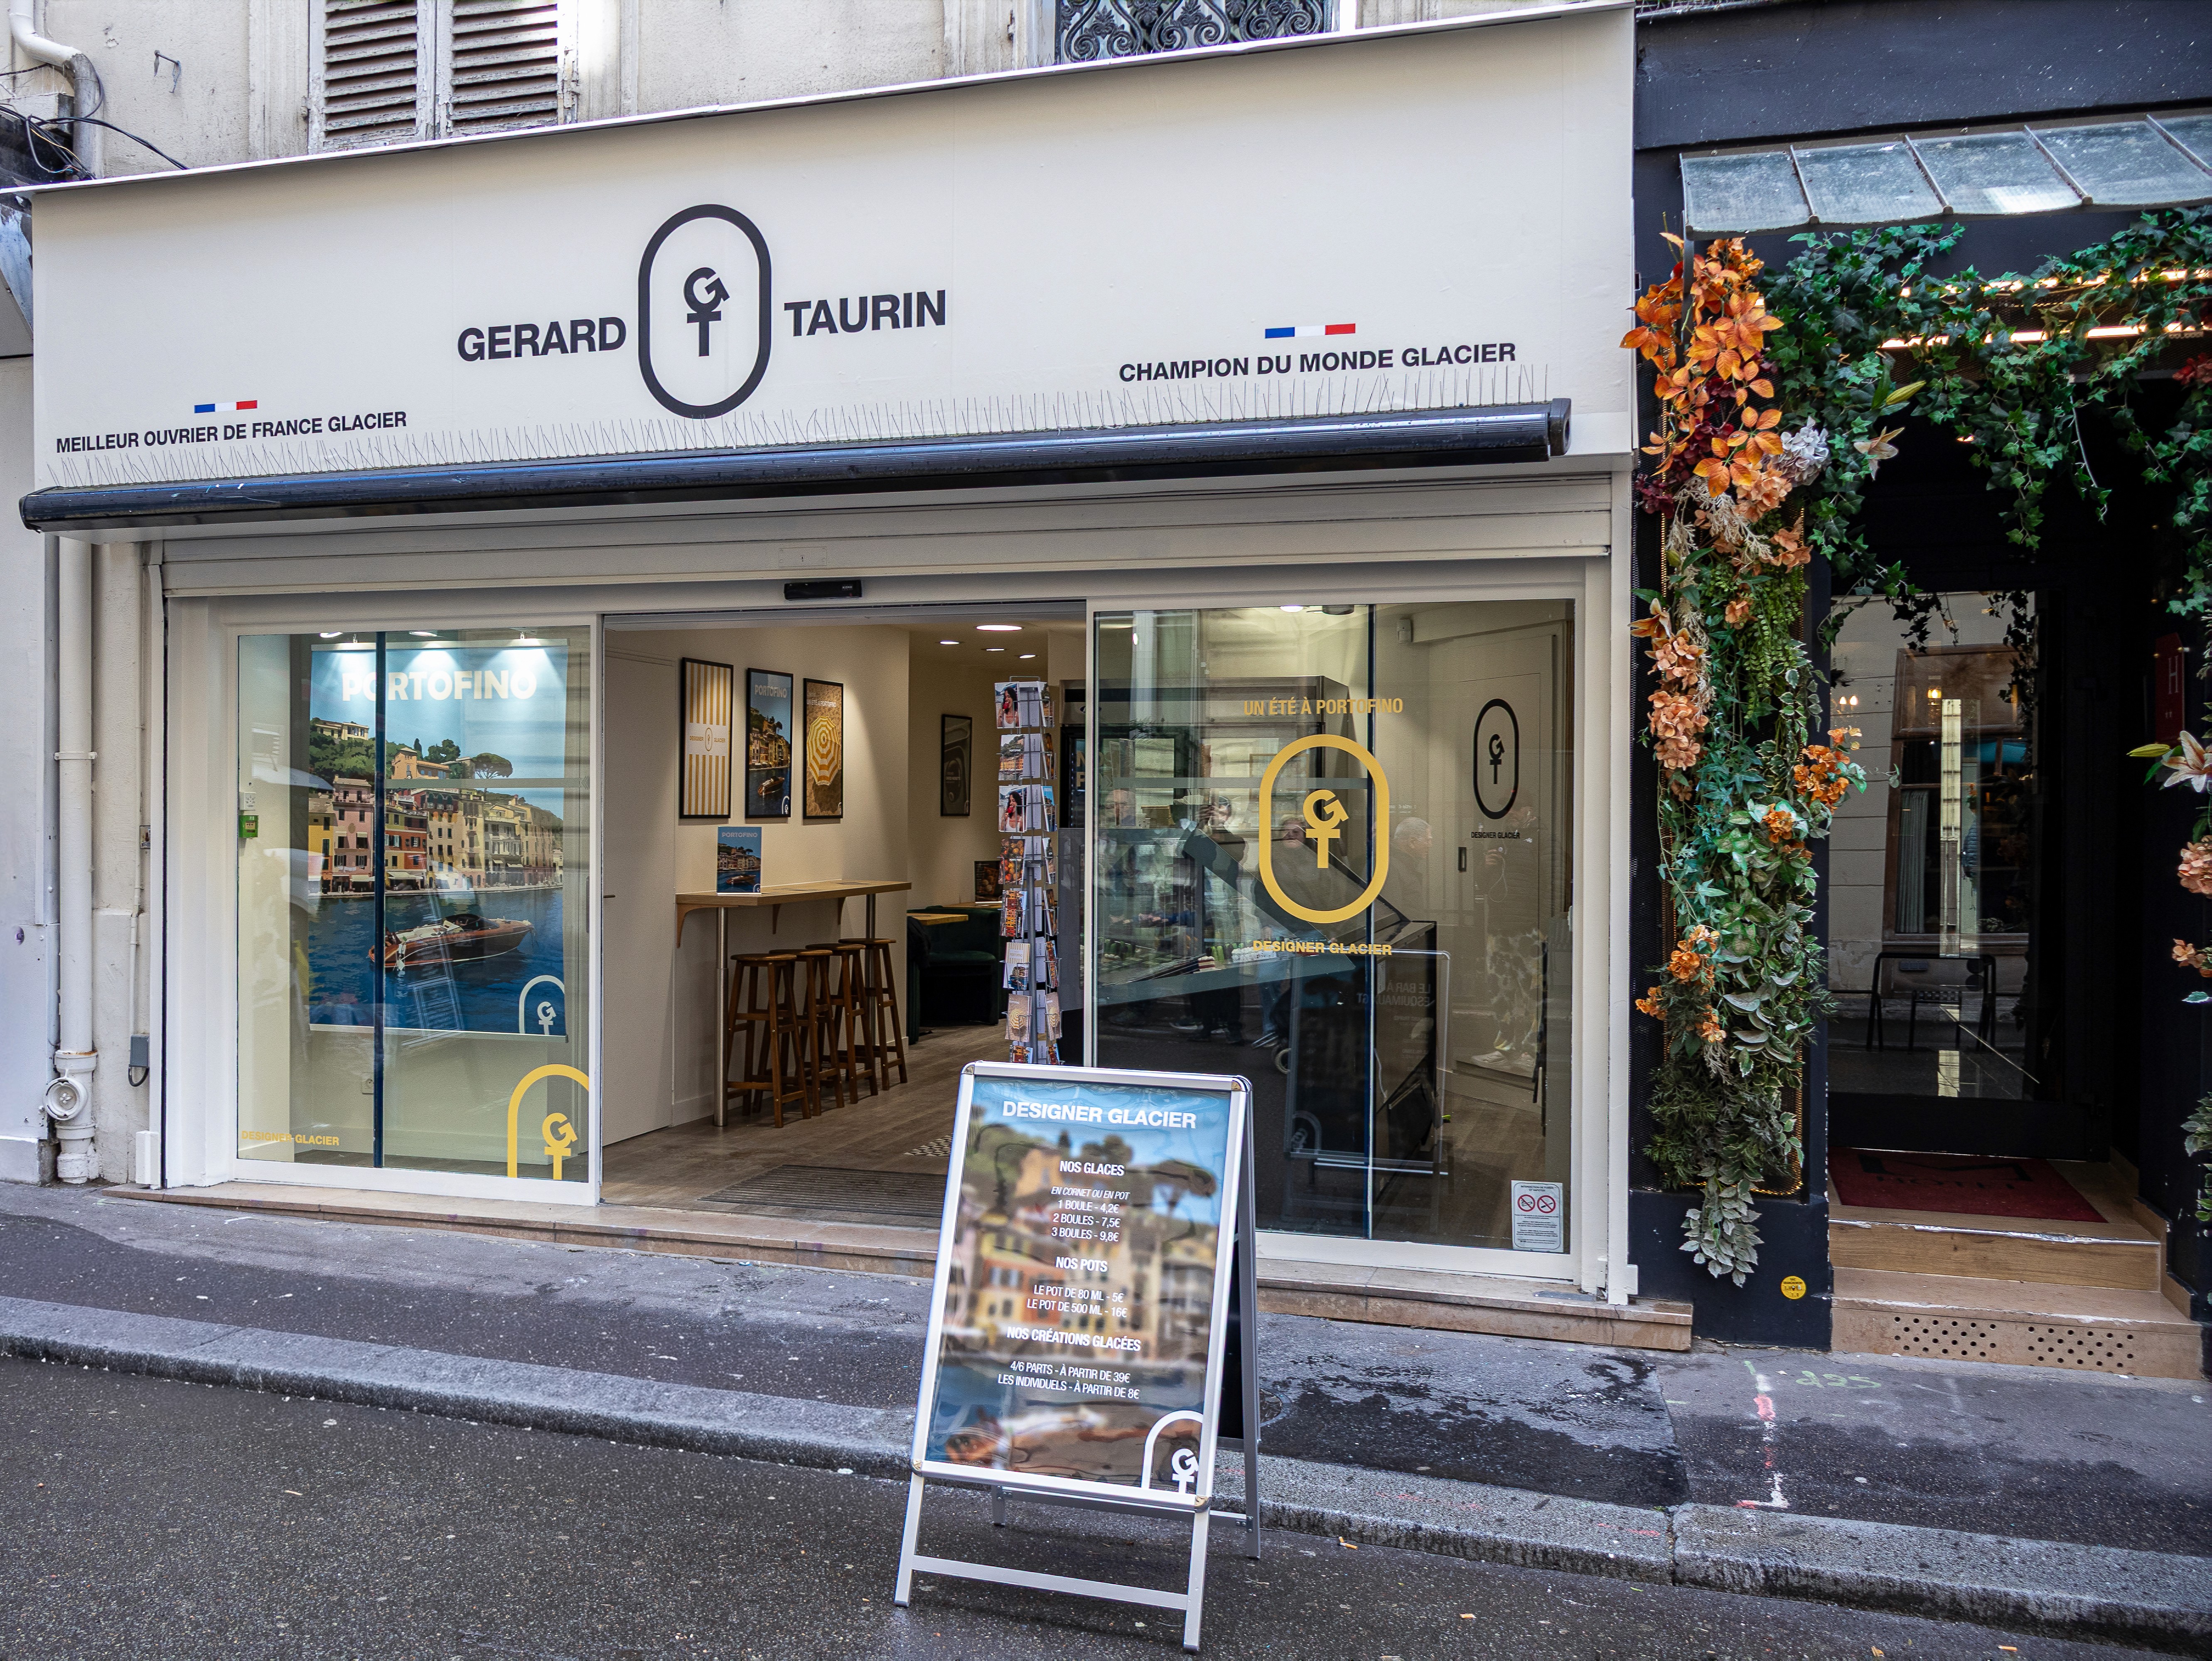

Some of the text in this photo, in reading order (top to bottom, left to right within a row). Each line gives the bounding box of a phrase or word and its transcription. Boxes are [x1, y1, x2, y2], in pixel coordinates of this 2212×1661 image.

[458, 317, 626, 361] GERARD
[784, 290, 945, 336] TAURIN
[1119, 343, 1515, 382] CHAMPION DU MONDE GLACIER
[57, 412, 406, 453] MEILLEUR OUVRIER DE FRANCE GLACIER
[342, 670, 537, 702] PORTOFINO
[755, 685, 787, 698] PORTOFINO
[1244, 697, 1403, 715] UN ÉTÉ À PORTOFINO
[1253, 940, 1391, 955] DESIGNER GLACIER
[1003, 1101, 1196, 1129] DESIGNER GLACIER
[241, 1131, 339, 1145] DESIGNER GLACIER
[1060, 1161, 1124, 1176] NOS GLACES
[1062, 1187, 1091, 1197] CORNET
[1091, 1190, 1103, 1198] OU
[1104, 1190, 1114, 1199] EN
[1114, 1191, 1130, 1200] POT
[1058, 1200, 1062, 1209] 1
[1065, 1200, 1093, 1211] BOULE
[1100, 1203, 1119, 1213] 4,2€
[1053, 1213, 1059, 1222] 2
[1060, 1214, 1094, 1225] BOULES
[1102, 1217, 1121, 1228] 7,5€
[1052, 1227, 1057, 1236] 3
[1059, 1227, 1092, 1239] BOULES
[1100, 1231, 1119, 1242] 9,8€
[1055, 1256, 1107, 1271] NOS POTS
[1034, 1284, 1044, 1295] LE
[1046, 1286, 1064, 1296] POT
[1064, 1287, 1076, 1298] DE
[1078, 1289, 1089, 1300] 80
[1091, 1289, 1104, 1300] ML
[1111, 1293, 1123, 1303] 5€
[1027, 1298, 1038, 1308] LE
[1039, 1300, 1057, 1310] POT
[1058, 1301, 1069, 1312] DE
[1071, 1303, 1088, 1313] 500
[1089, 1305, 1102, 1315] ML
[1111, 1307, 1127, 1317] 16€
[1007, 1327, 1141, 1351] NOS CRÉATIONS GLACÉES
[1010, 1361, 1025, 1371] 4/6
[1026, 1362, 1053, 1374] PARTS
[1059, 1364, 1066, 1376] À
[1068, 1367, 1098, 1379] PARTIR
[1100, 1370, 1111, 1381] DE
[1113, 1372, 1130, 1383] 39€
[998, 1374, 1014, 1385] LES
[1016, 1375, 1067, 1391] INDIVIDUELS
[1073, 1380, 1080, 1392] À
[1082, 1383, 1112, 1396] PARTIR
[1114, 1387, 1126, 1397] DE
[1128, 1389, 1140, 1399] 8€
